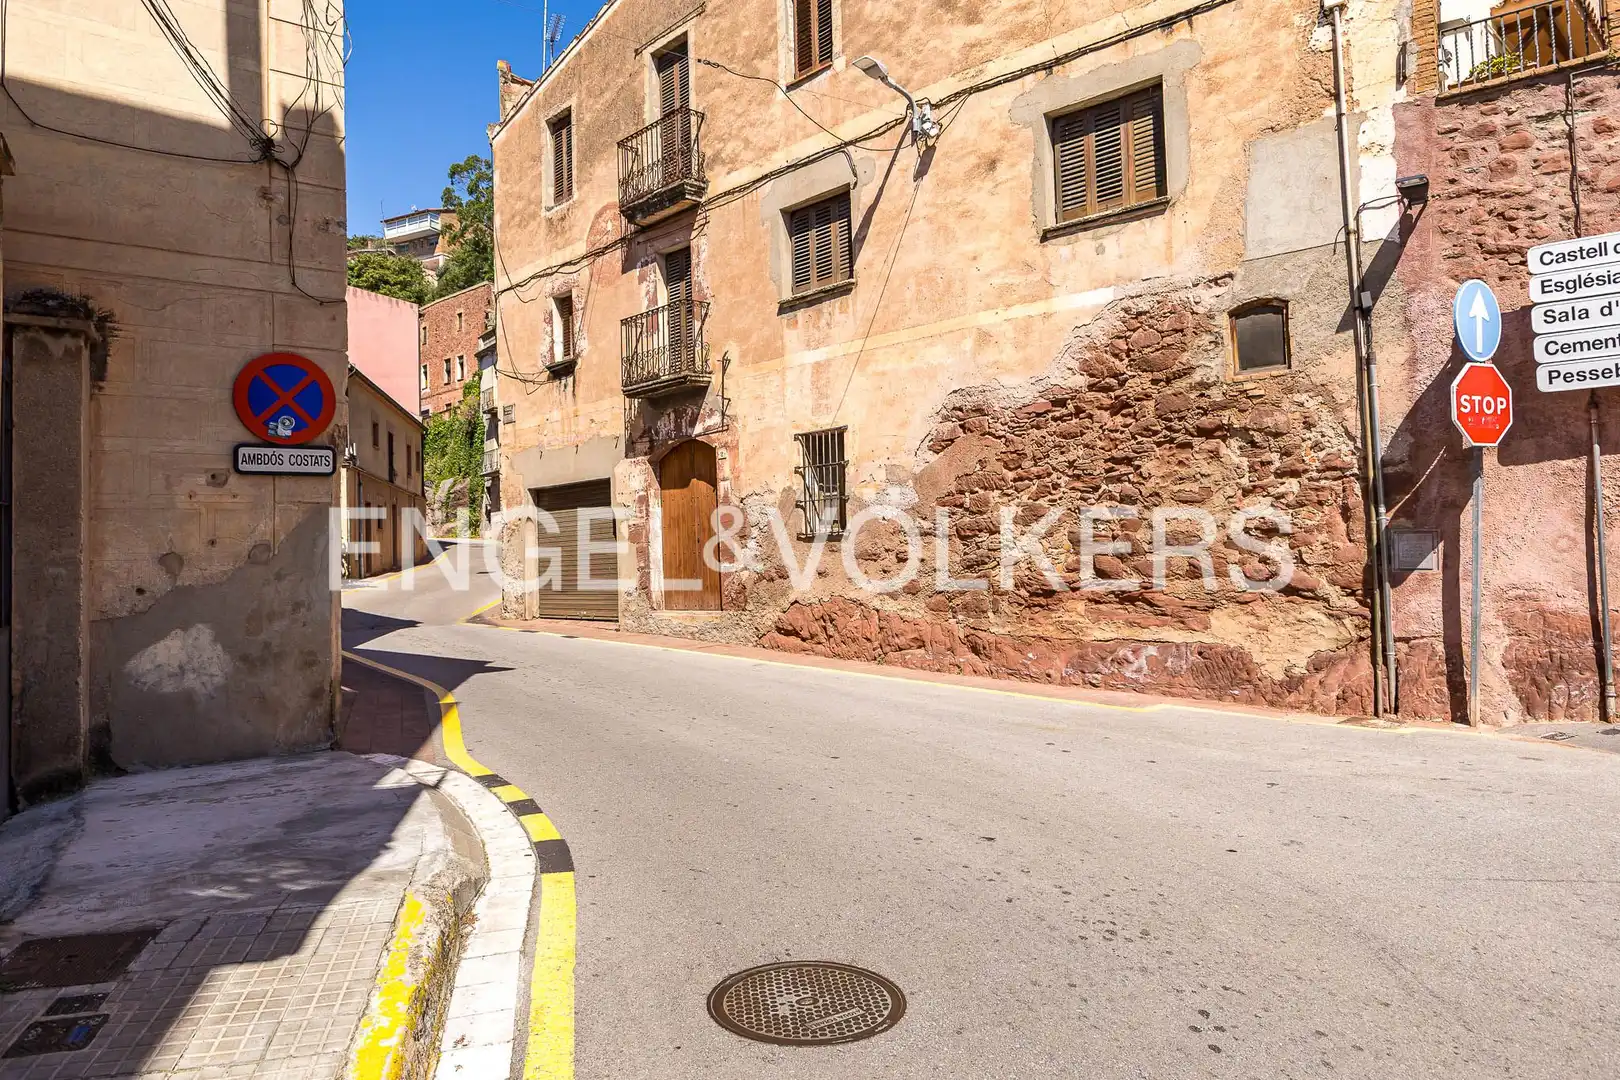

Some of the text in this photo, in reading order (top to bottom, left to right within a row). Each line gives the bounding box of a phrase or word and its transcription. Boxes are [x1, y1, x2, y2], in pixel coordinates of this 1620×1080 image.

[1540, 241, 1608, 266] Castell
[1541, 270, 1620, 295] Església
[1543, 306, 1590, 324] Sala
[1460, 394, 1507, 415] STOP
[241, 450, 331, 467] AMBDÓS COSTATS
